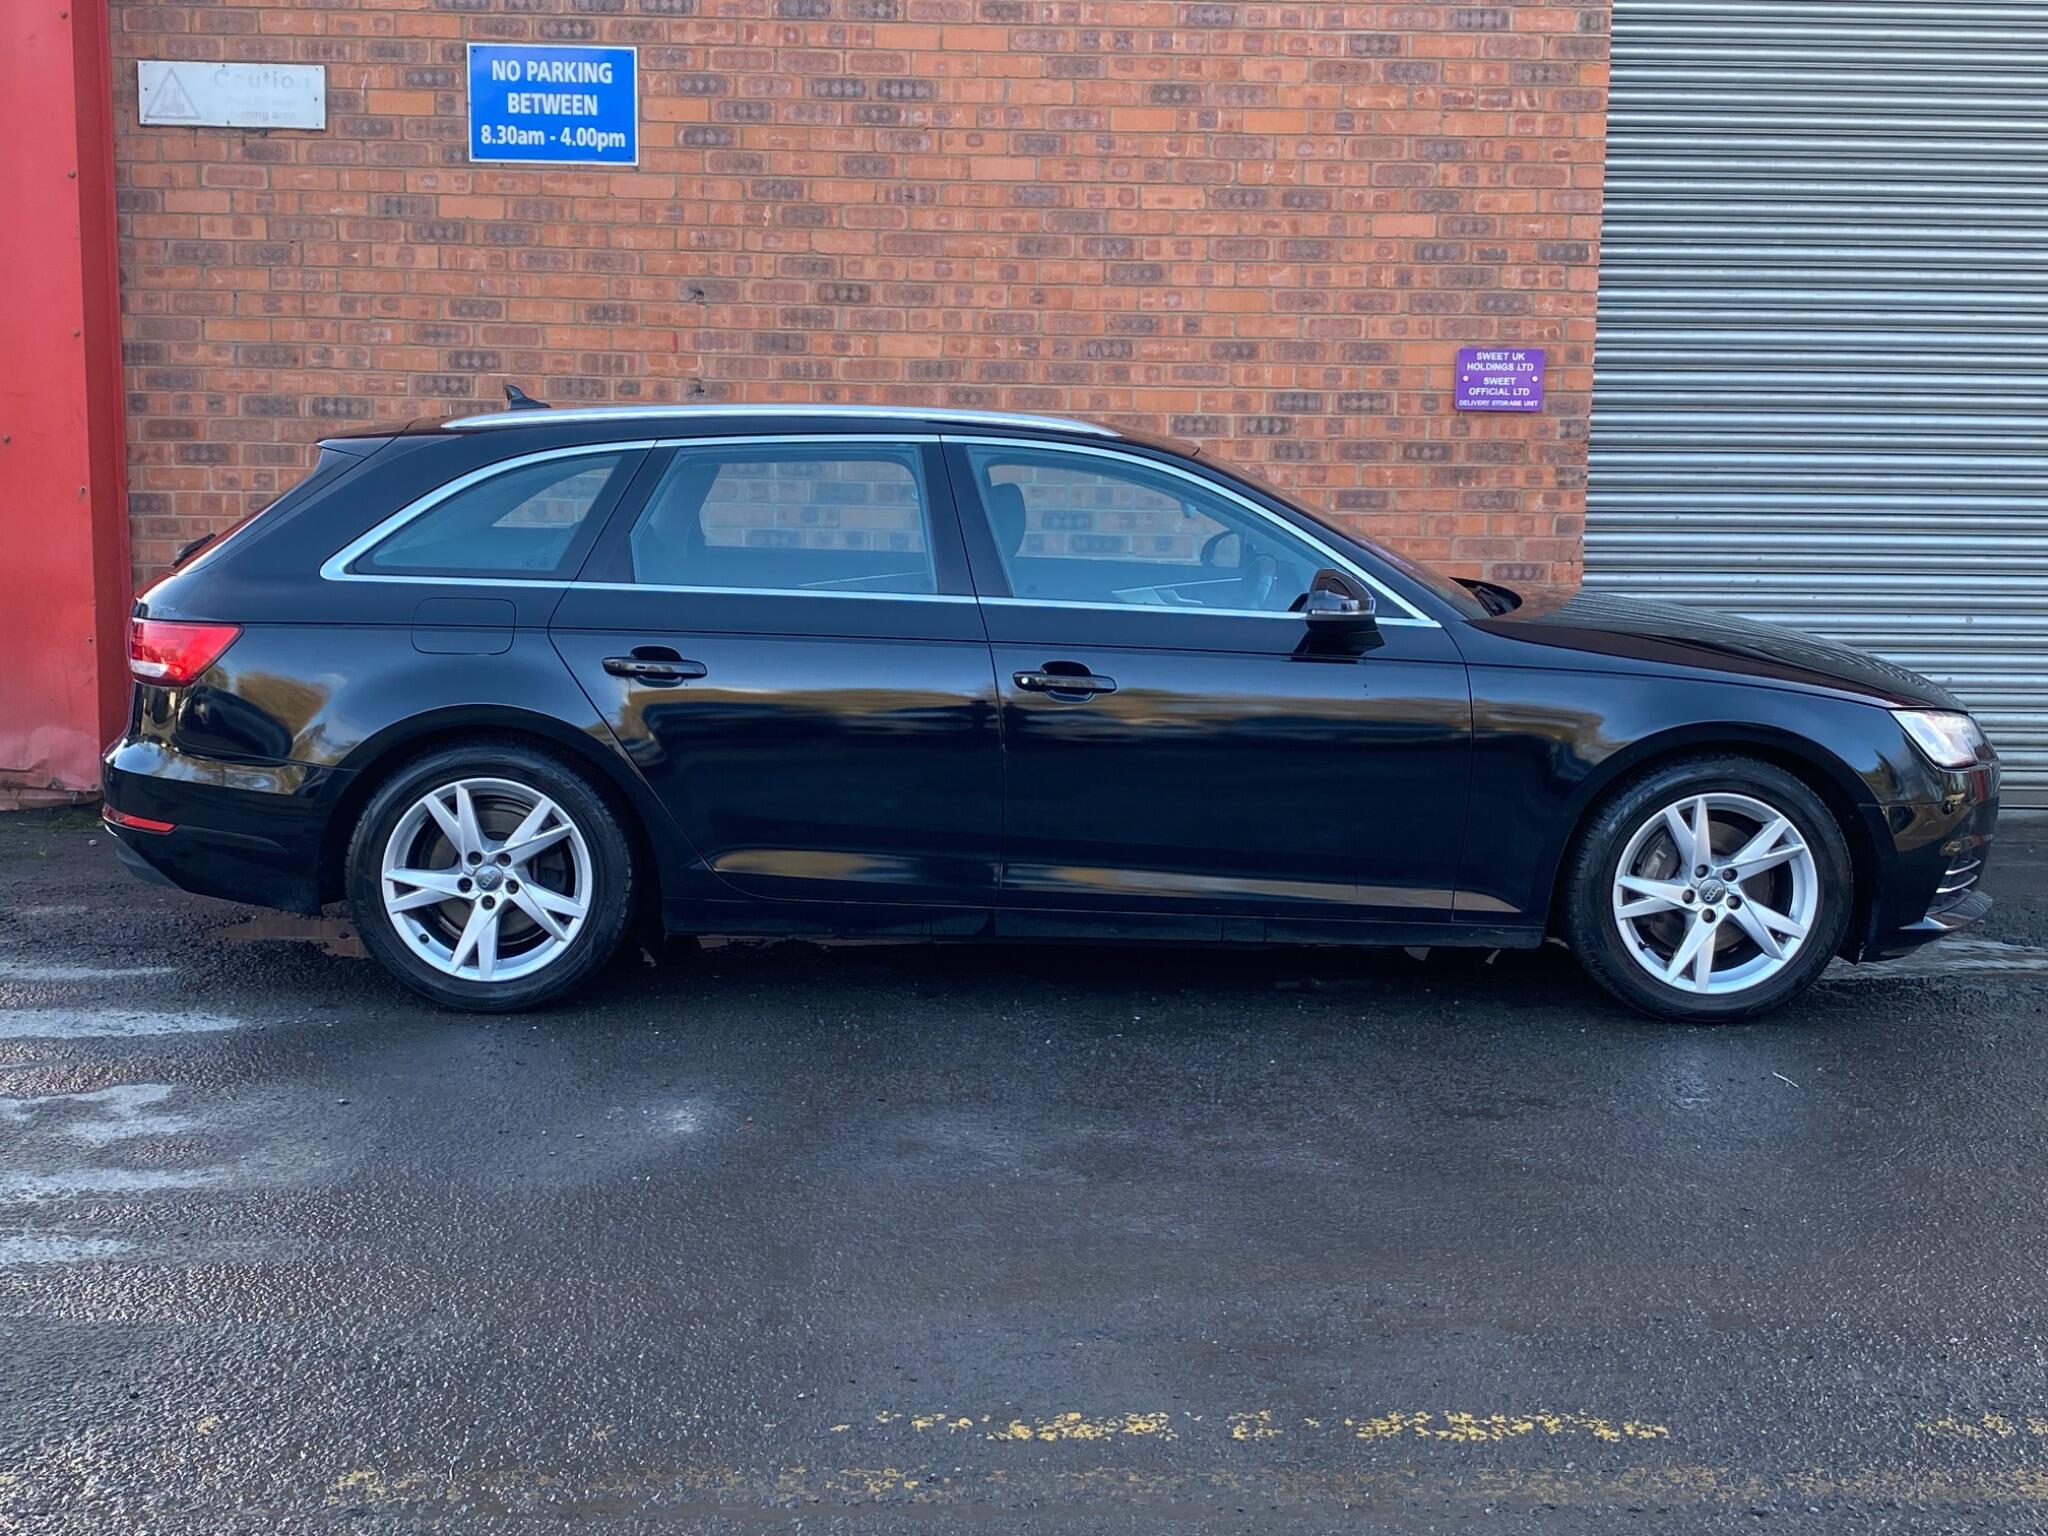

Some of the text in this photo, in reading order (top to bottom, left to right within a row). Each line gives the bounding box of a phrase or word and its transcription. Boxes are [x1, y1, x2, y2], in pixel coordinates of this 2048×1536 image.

[492, 60, 613, 84] NO PARKING
[507, 92, 598, 116] BETWEEN
[480, 124, 545, 146] 8.30am
[559, 126, 626, 152] 4.00pm
[1476, 352, 1525, 361] SWEET UK
[1466, 362, 1534, 371] HOLDINGS LTD
[1483, 376, 1517, 386] SWEET
[1468, 387, 1530, 396] OFFICIAL LTD
[1491, 399, 1522, 407] STORAGE
